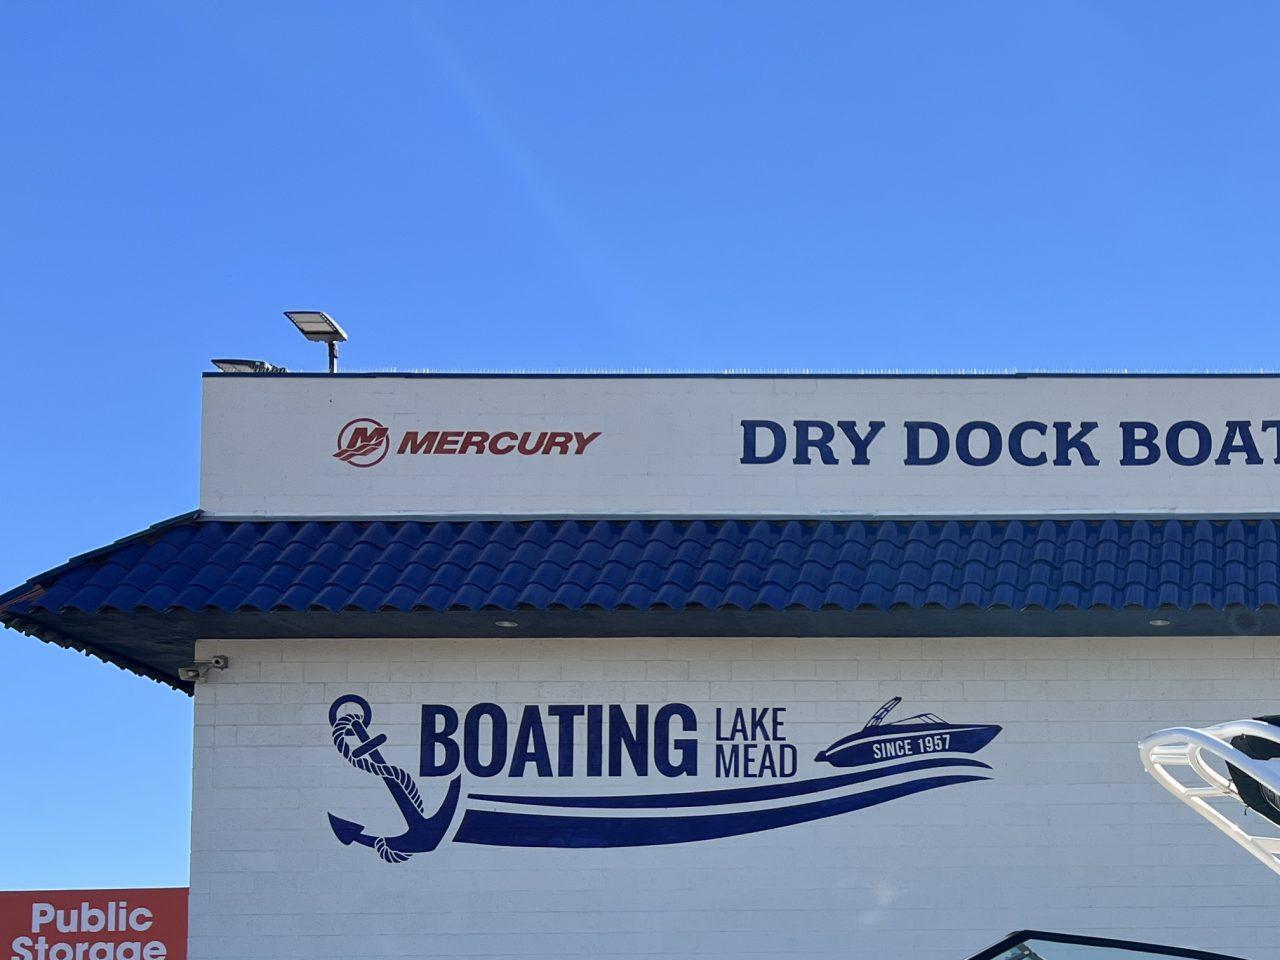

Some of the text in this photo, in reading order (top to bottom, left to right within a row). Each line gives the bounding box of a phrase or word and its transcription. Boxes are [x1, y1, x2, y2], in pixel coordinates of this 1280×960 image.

[397, 431, 602, 456] MERCURY
[740, 420, 886, 466] DRY
[904, 420, 1102, 467] DOCK
[420, 703, 699, 778] BOATING
[716, 707, 787, 742] LAKE
[716, 743, 798, 778] MEAD
[872, 734, 951, 759] SINCE 1957
[31, 901, 153, 933] Public
